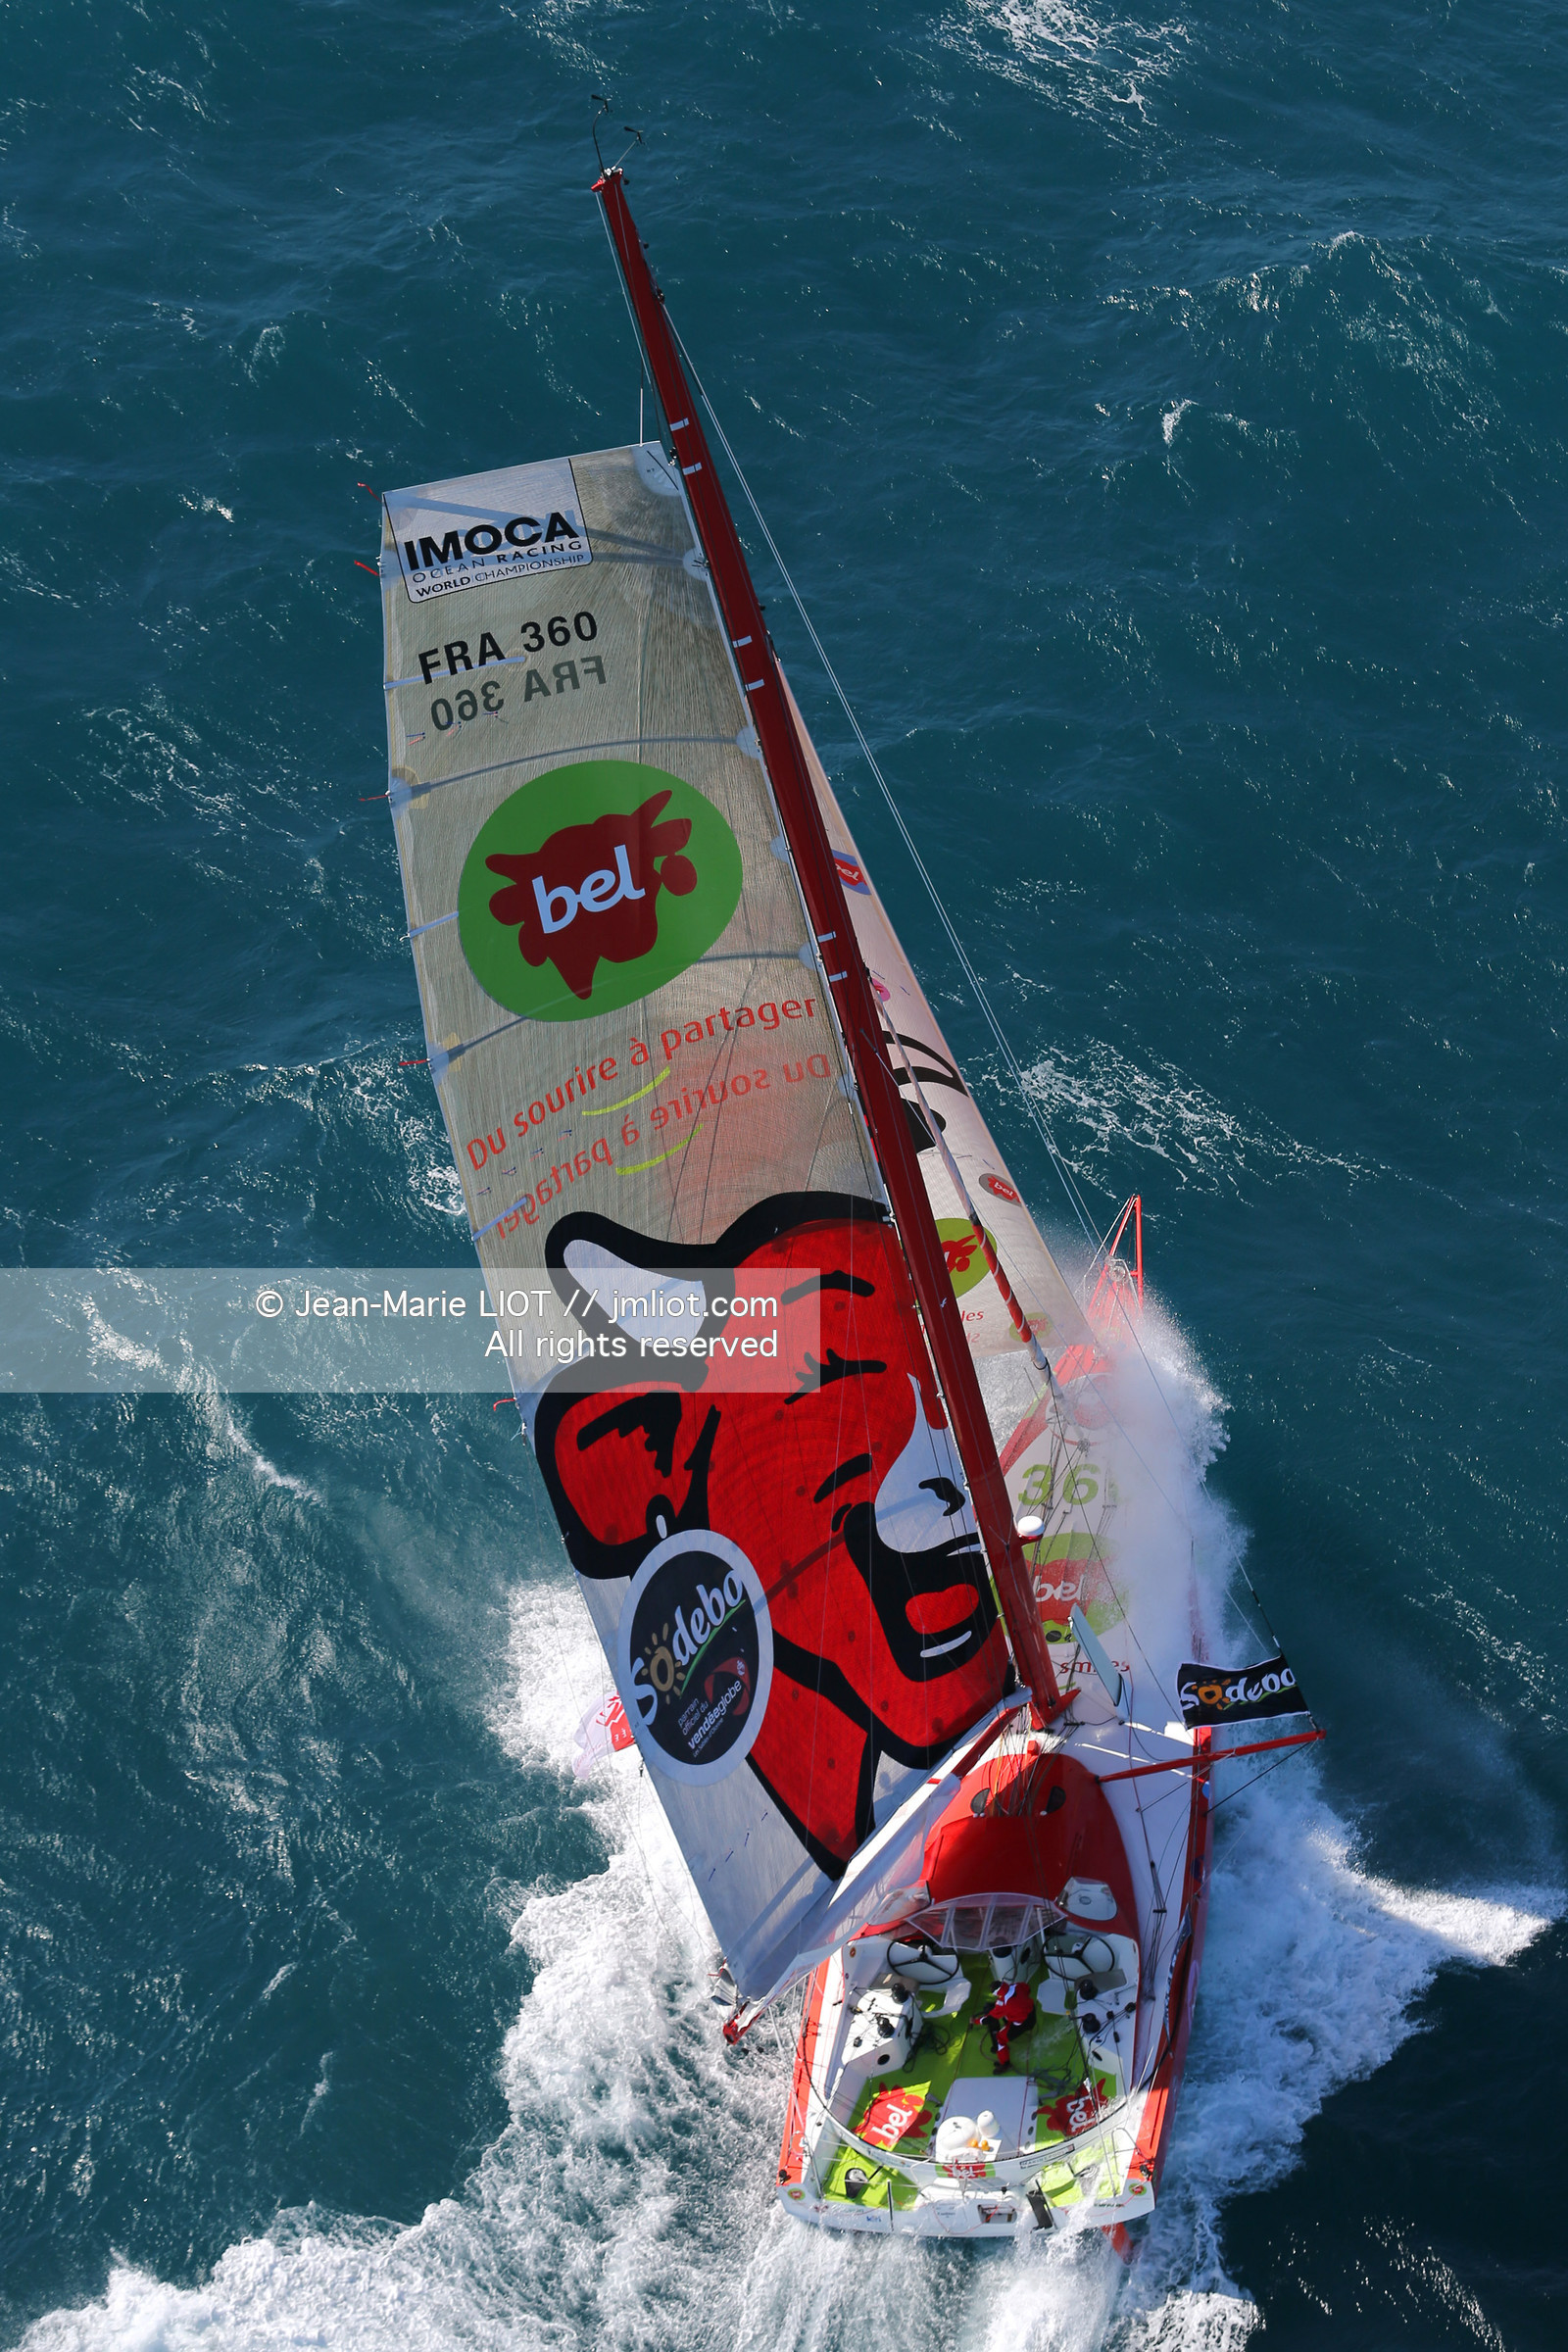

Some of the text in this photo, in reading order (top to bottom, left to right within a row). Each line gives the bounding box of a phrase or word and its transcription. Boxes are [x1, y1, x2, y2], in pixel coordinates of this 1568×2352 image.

[404, 512, 579, 570] IMOCA
[413, 541, 582, 583] OCEAN RACING
[416, 554, 584, 597] WORLD CHAMPIONSHIP
[417, 611, 598, 684] FRA 360
[532, 845, 646, 934] bel
[466, 998, 816, 1170] Du sourire à partager
[994, 1181, 1013, 1198] bel
[1060, 1660, 1130, 1674] smes
[678, 1697, 699, 1728] parrain
[688, 1680, 742, 1749] vendéeglobe
[700, 1701, 709, 1713] du
[871, 2103, 912, 2140] bel
[1066, 2095, 1096, 2133] bel
